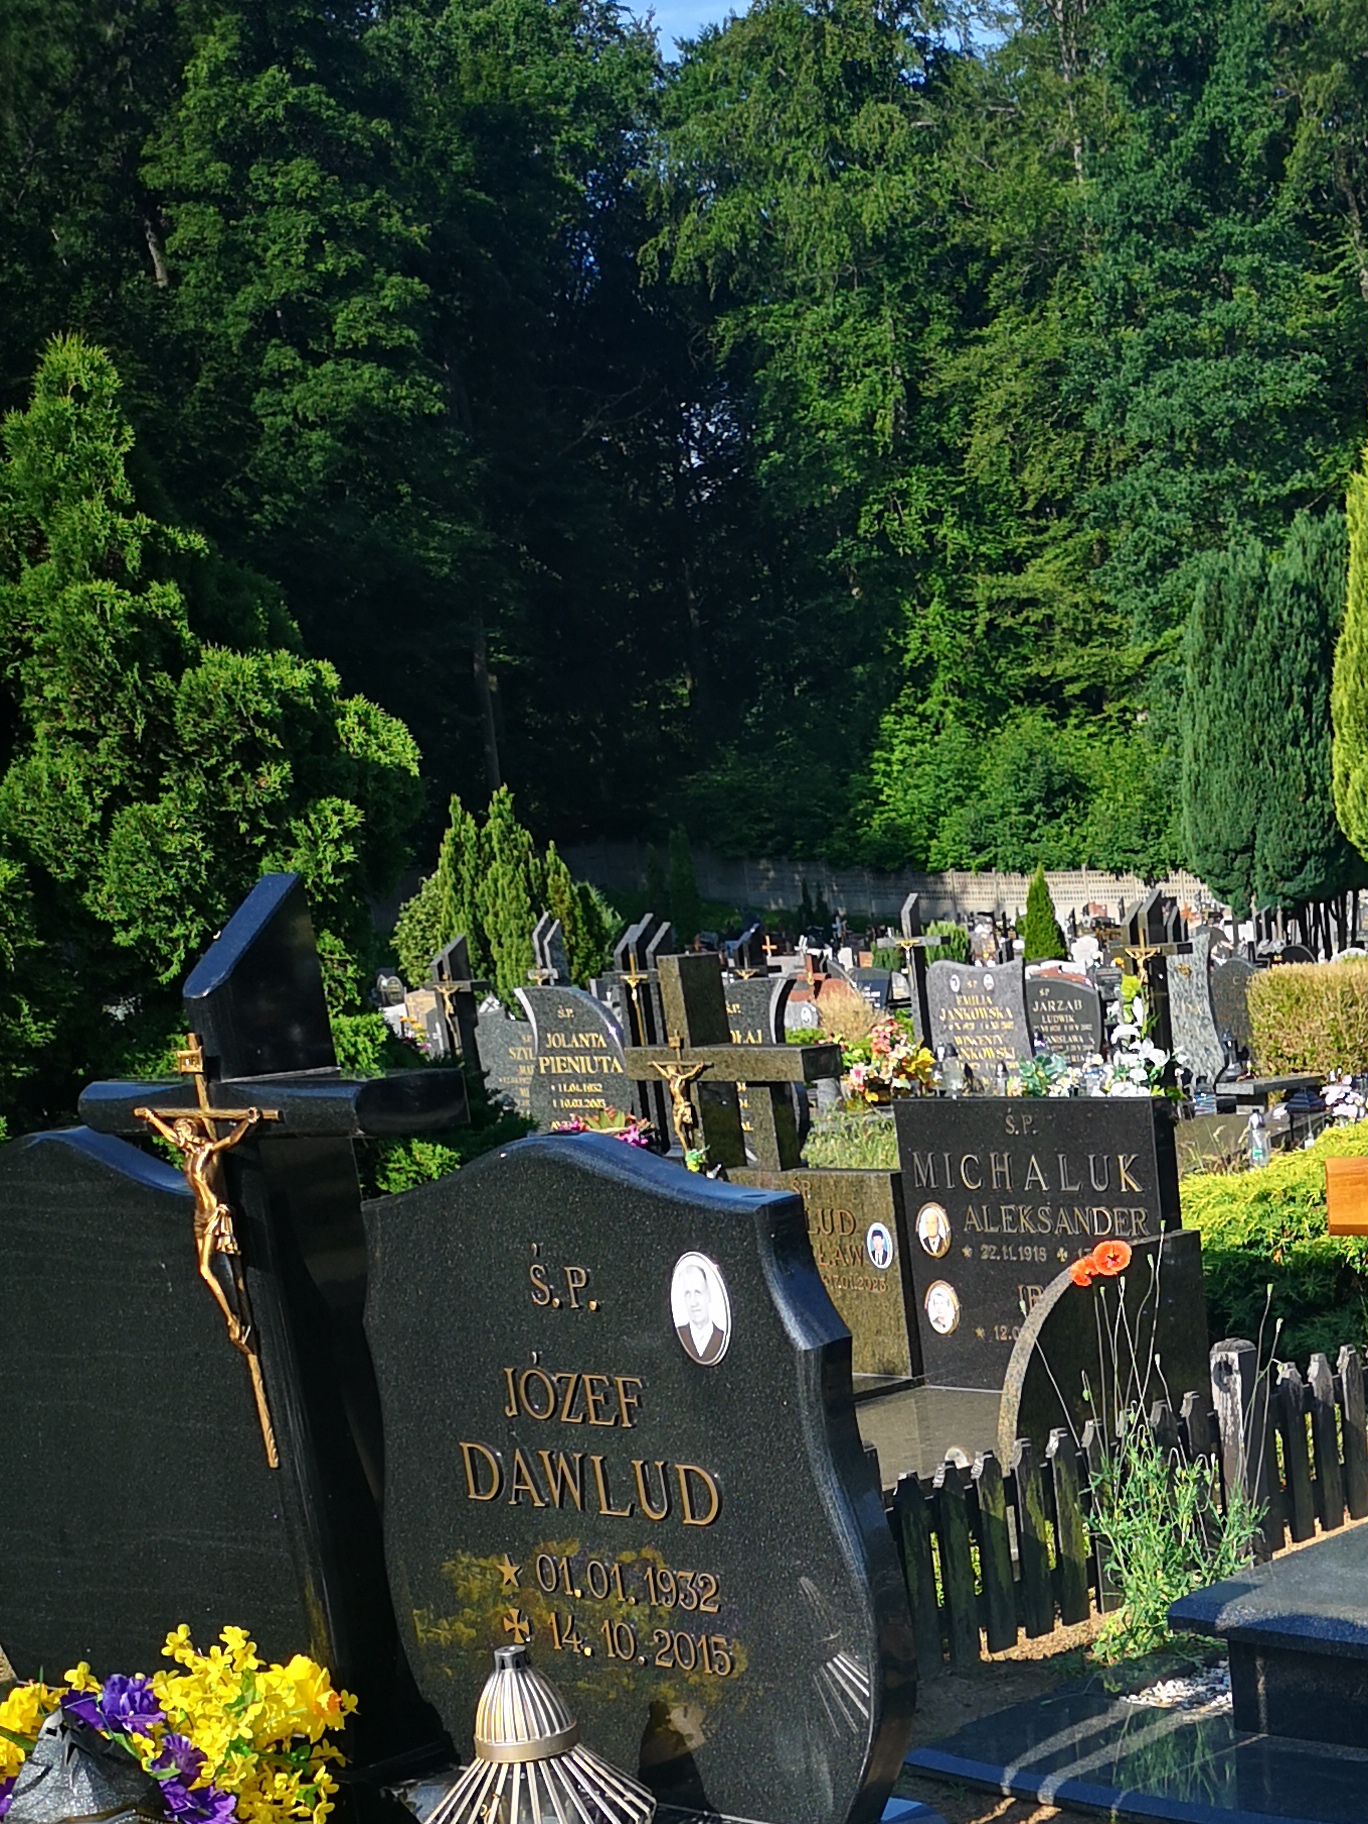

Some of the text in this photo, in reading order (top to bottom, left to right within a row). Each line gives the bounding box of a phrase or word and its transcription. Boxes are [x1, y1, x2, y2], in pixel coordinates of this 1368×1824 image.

[545, 1032, 608, 1049] JOLANTA
[538, 1055, 624, 1075] PIENIUTA
[912, 1151, 1144, 1194] MICHALUK
[962, 1203, 1151, 1238] ALEKSANDER
[503, 1350, 643, 1428] JÓZEF
[459, 1441, 722, 1527] DAWLUD
